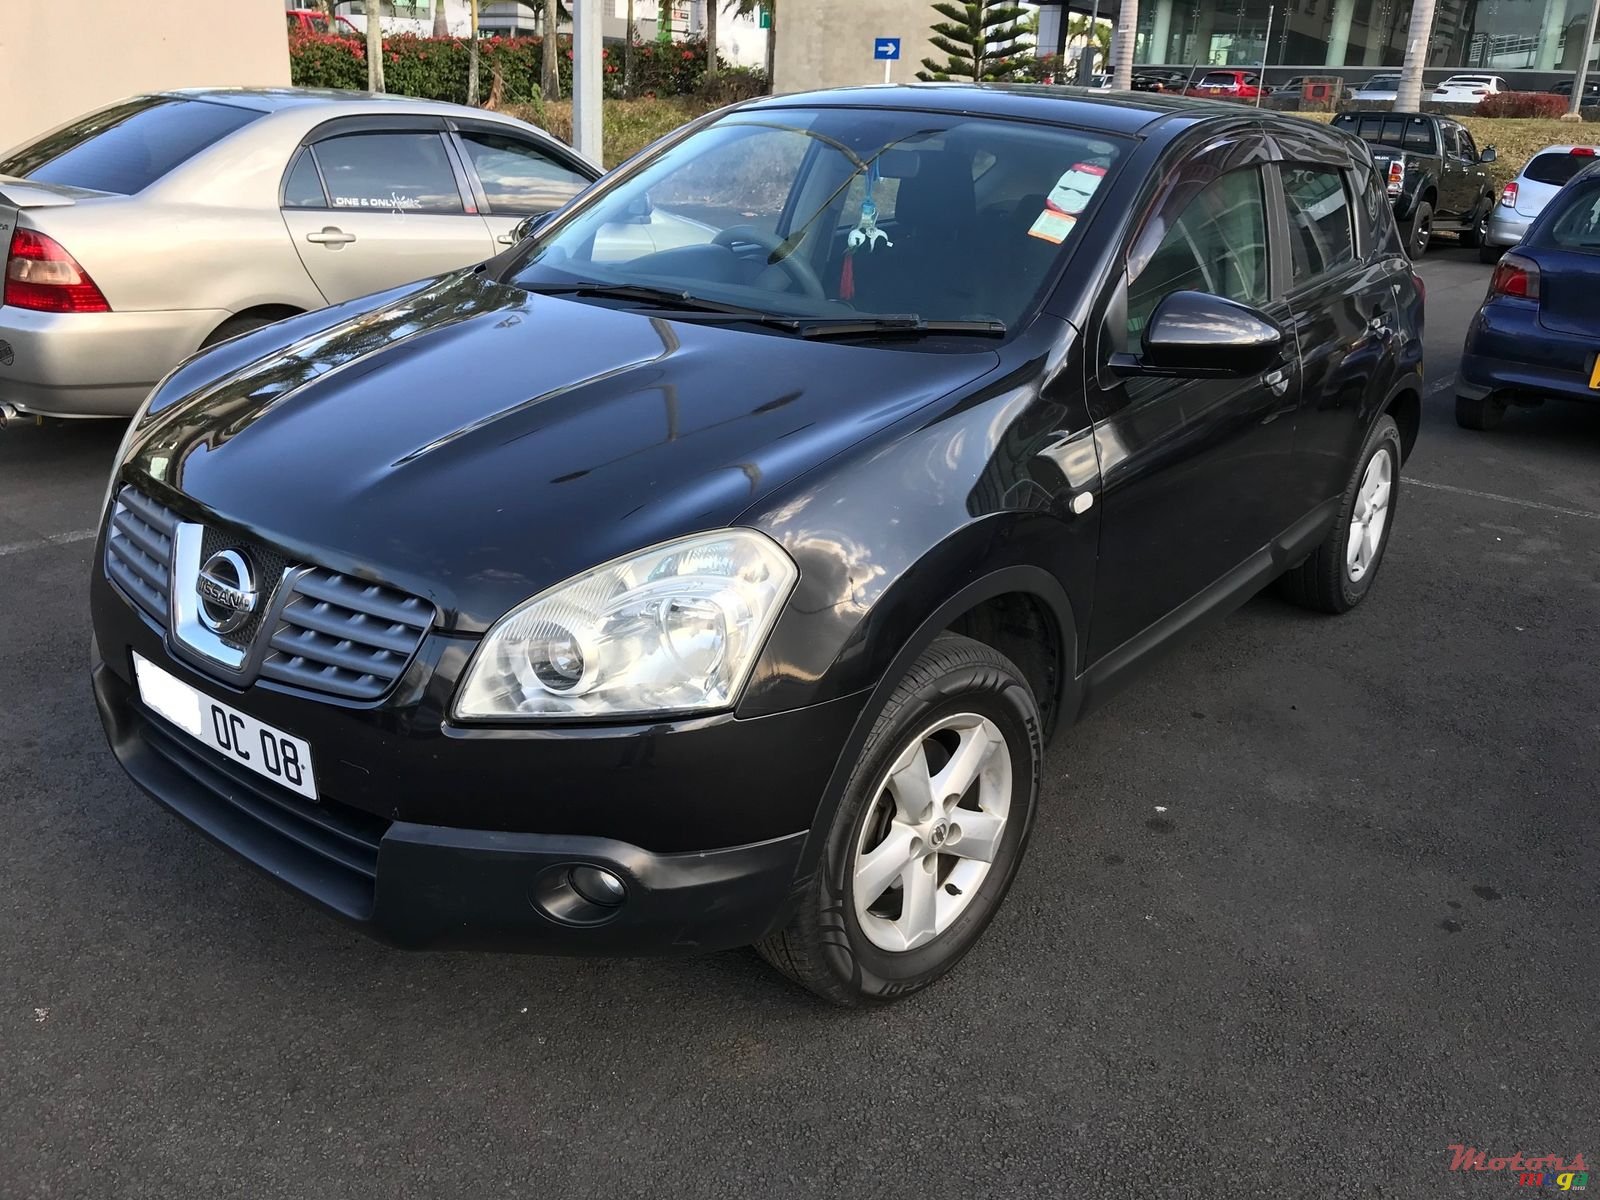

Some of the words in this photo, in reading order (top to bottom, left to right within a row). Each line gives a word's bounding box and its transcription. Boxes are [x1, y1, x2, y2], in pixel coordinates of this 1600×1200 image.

[336, 197, 360, 206] ONE
[361, 198, 369, 206] &
[370, 198, 397, 207] ONLY
[260, 728, 303, 786] 08
